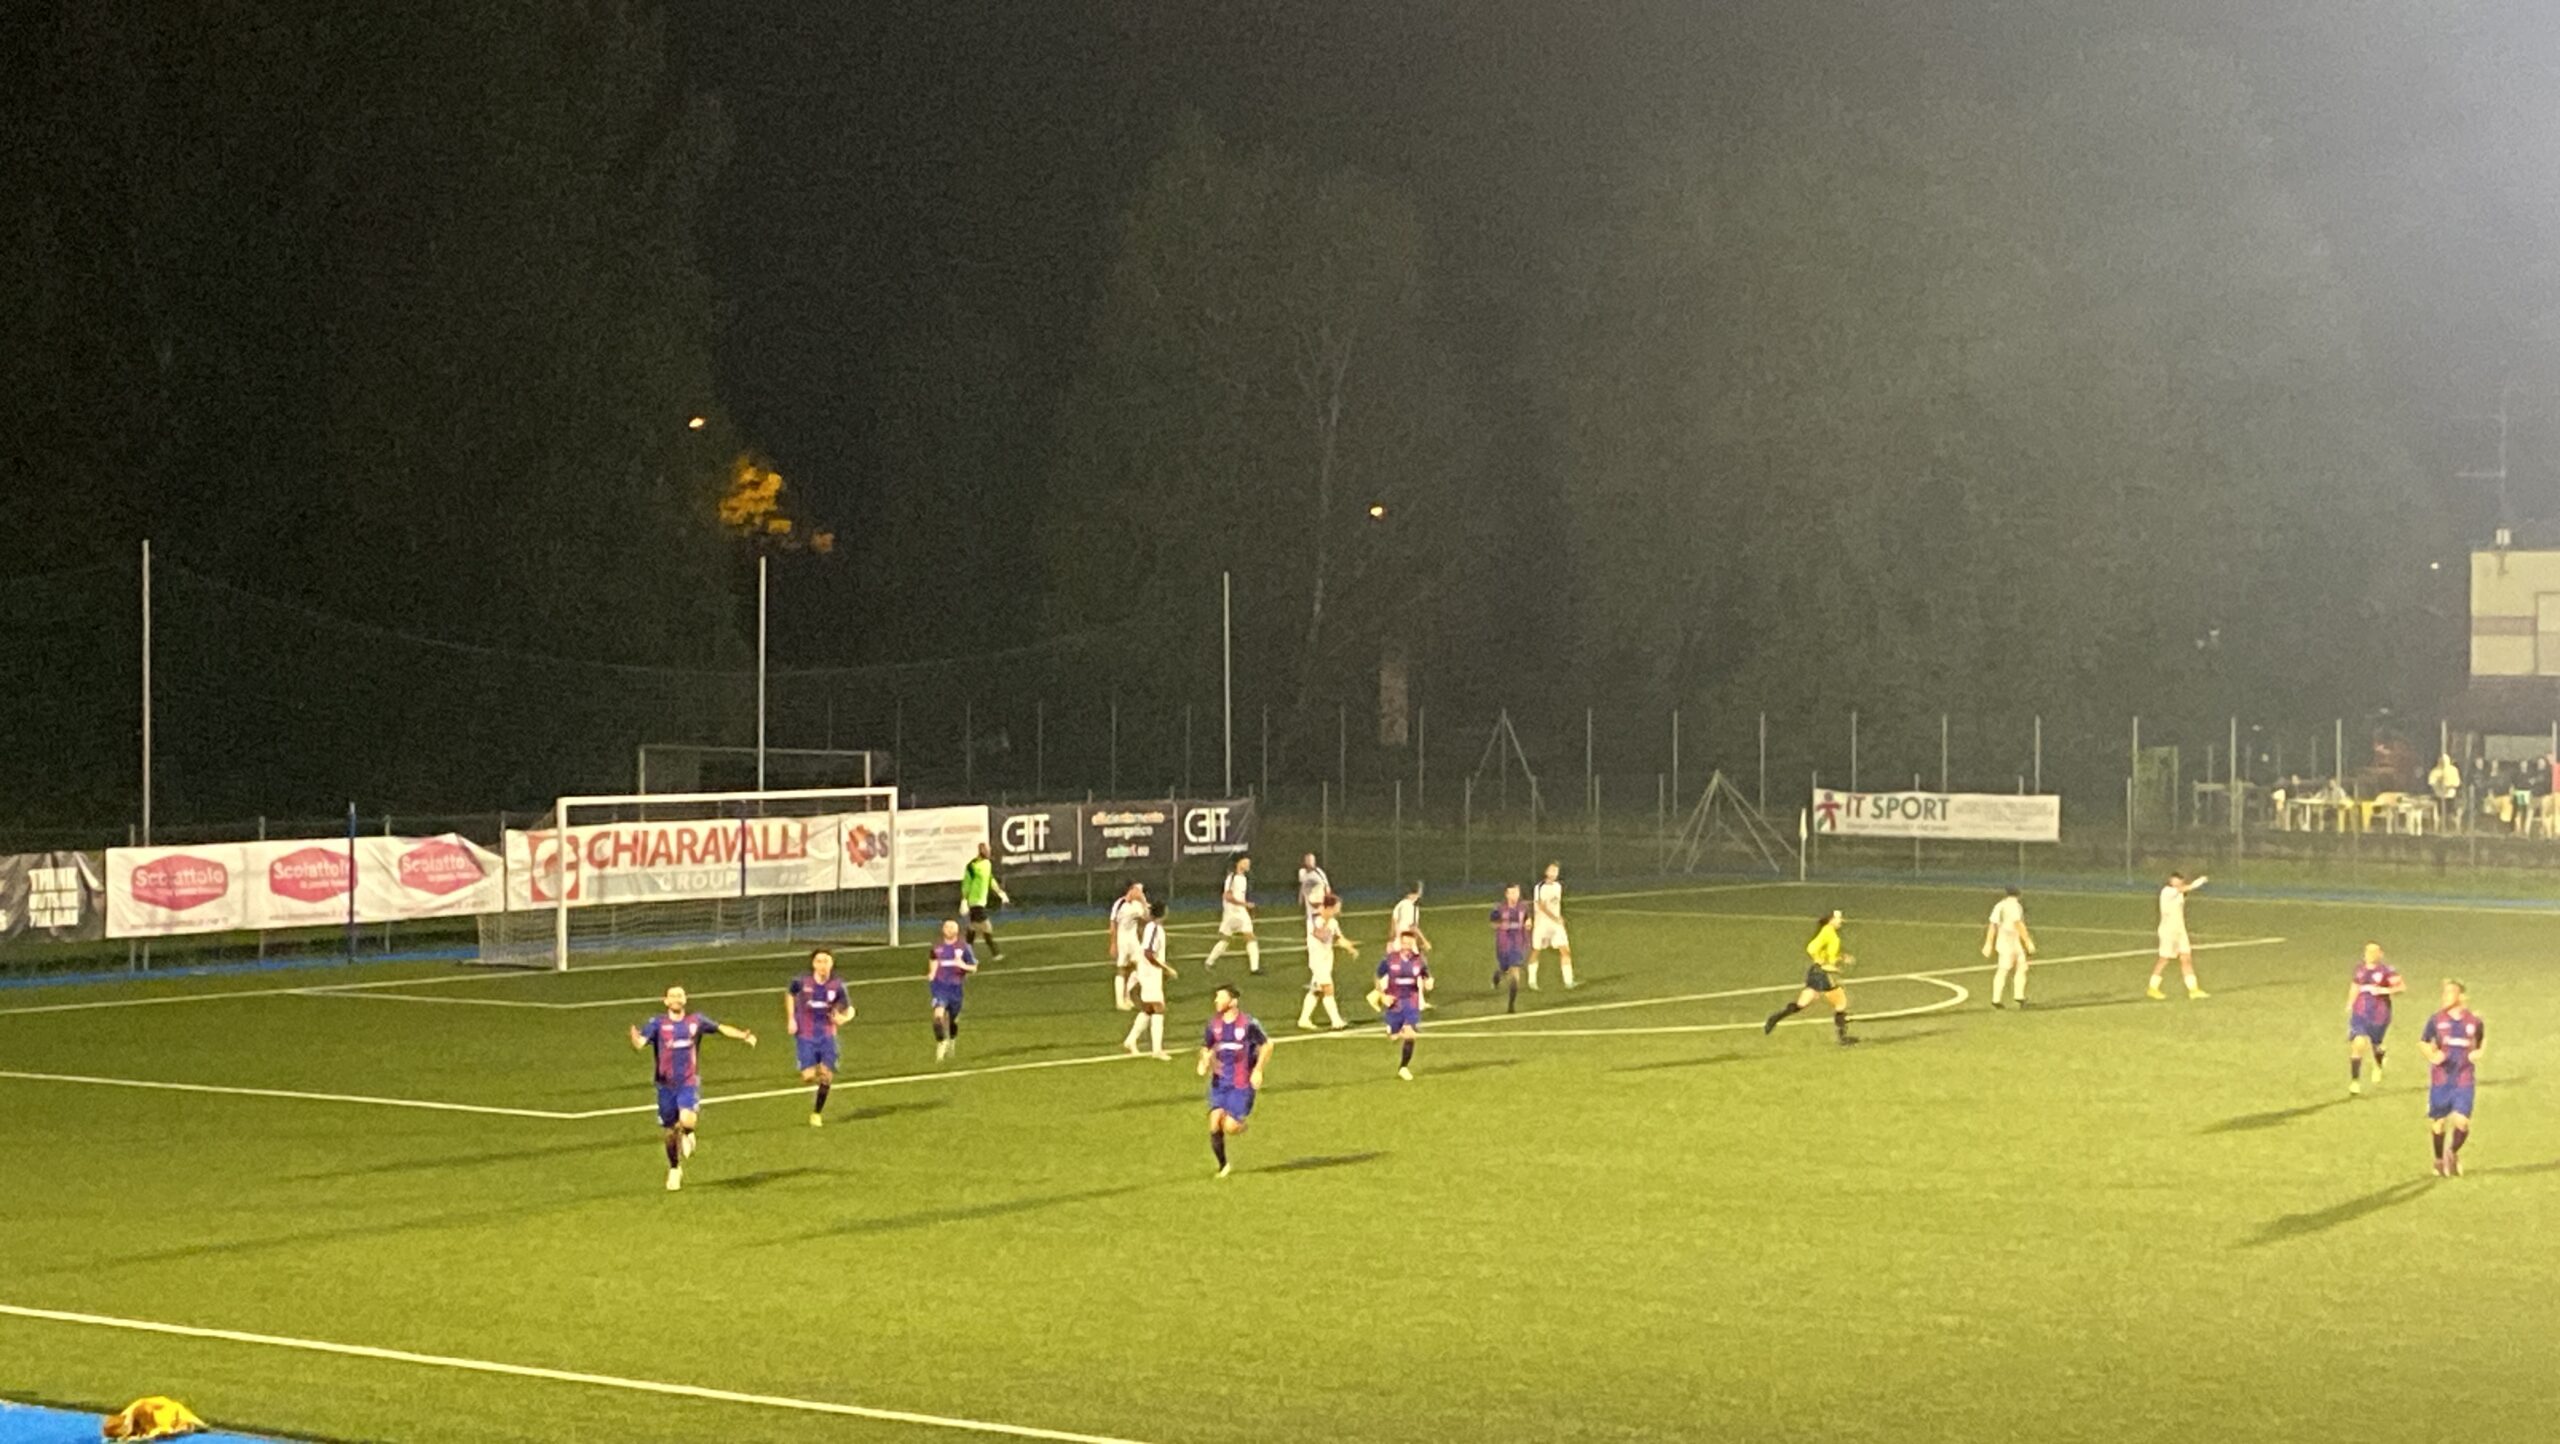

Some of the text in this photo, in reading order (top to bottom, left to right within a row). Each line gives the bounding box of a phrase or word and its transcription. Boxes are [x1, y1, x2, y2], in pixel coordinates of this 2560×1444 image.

[1871, 796, 1950, 821] SPORT
[585, 822, 809, 869] CHIARAVALLI
[135, 867, 225, 887] Scoattolo
[652, 871, 738, 892] GROUP
